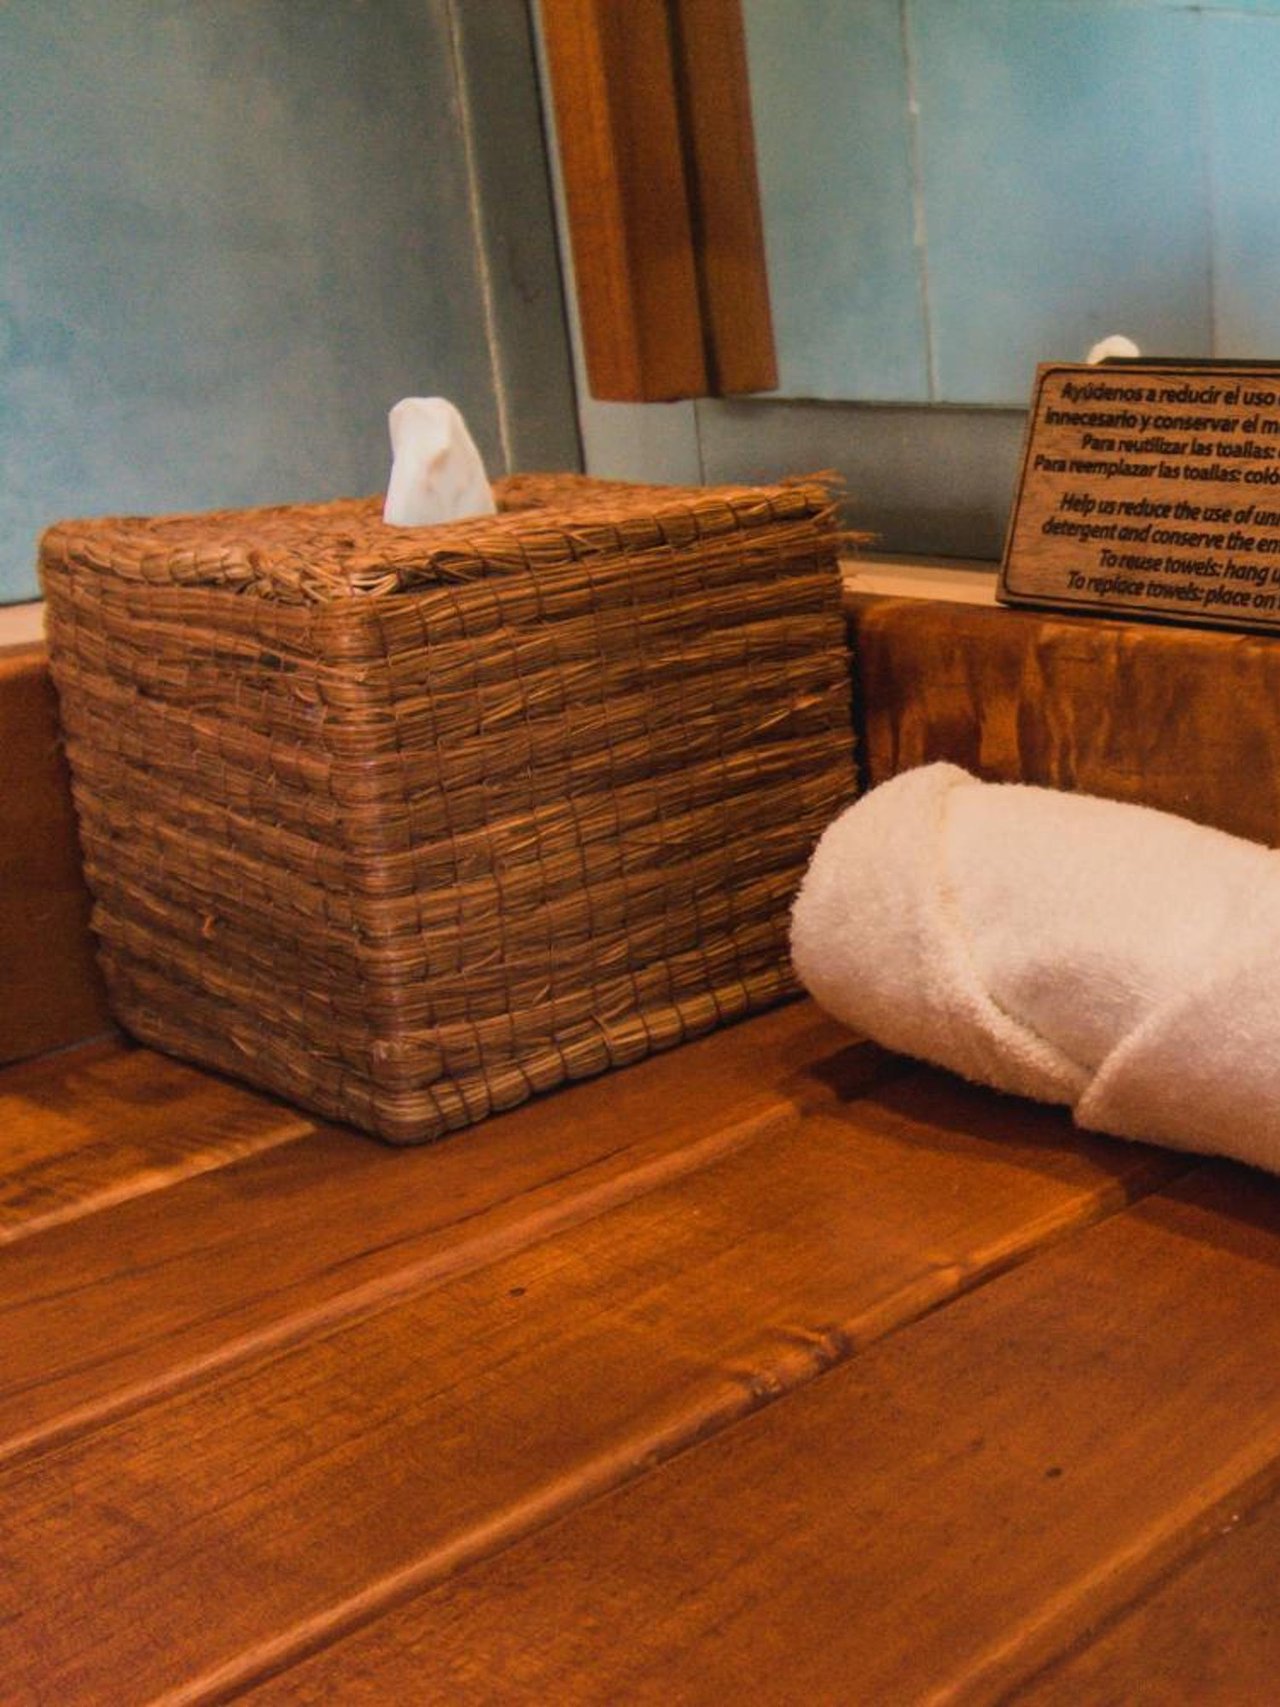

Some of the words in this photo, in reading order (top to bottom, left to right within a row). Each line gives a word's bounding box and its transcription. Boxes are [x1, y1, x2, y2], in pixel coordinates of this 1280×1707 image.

[1061, 382, 1143, 402] Ayúdenos
[1144, 388, 1156, 402] a
[1160, 384, 1221, 403] reducir
[1224, 386, 1240, 405] el
[1243, 392, 1276, 406] uso
[1045, 407, 1136, 428] innecesario
[1137, 414, 1152, 433] y
[1153, 415, 1239, 432] conservar
[1242, 414, 1258, 434] el
[1082, 433, 1116, 450] Para
[1119, 436, 1189, 455] reutilizar
[1191, 438, 1213, 455] las
[1216, 441, 1276, 460] toallas:
[1034, 453, 1066, 472] Para
[1069, 458, 1158, 479] reemplazar
[1158, 461, 1180, 479] las
[1183, 463, 1242, 482] toallas:
[1060, 493, 1096, 516] Help
[1098, 499, 1115, 515] us
[1117, 497, 1172, 518] reduce
[1173, 500, 1201, 520] the
[1203, 507, 1232, 523] use
[1234, 505, 1256, 524] of
[1042, 516, 1119, 542] detergent
[1118, 524, 1152, 542] and
[1152, 529, 1225, 549] conserve
[1226, 531, 1257, 549] the
[1100, 549, 1119, 568] To
[1120, 556, 1163, 572] reuse
[1164, 556, 1222, 578] towels:
[1223, 559, 1271, 586] hang
[1067, 570, 1086, 589] To
[1087, 574, 1145, 596] replace
[1146, 581, 1204, 600] towels:
[1203, 585, 1251, 607] place
[1252, 594, 1277, 610] on
